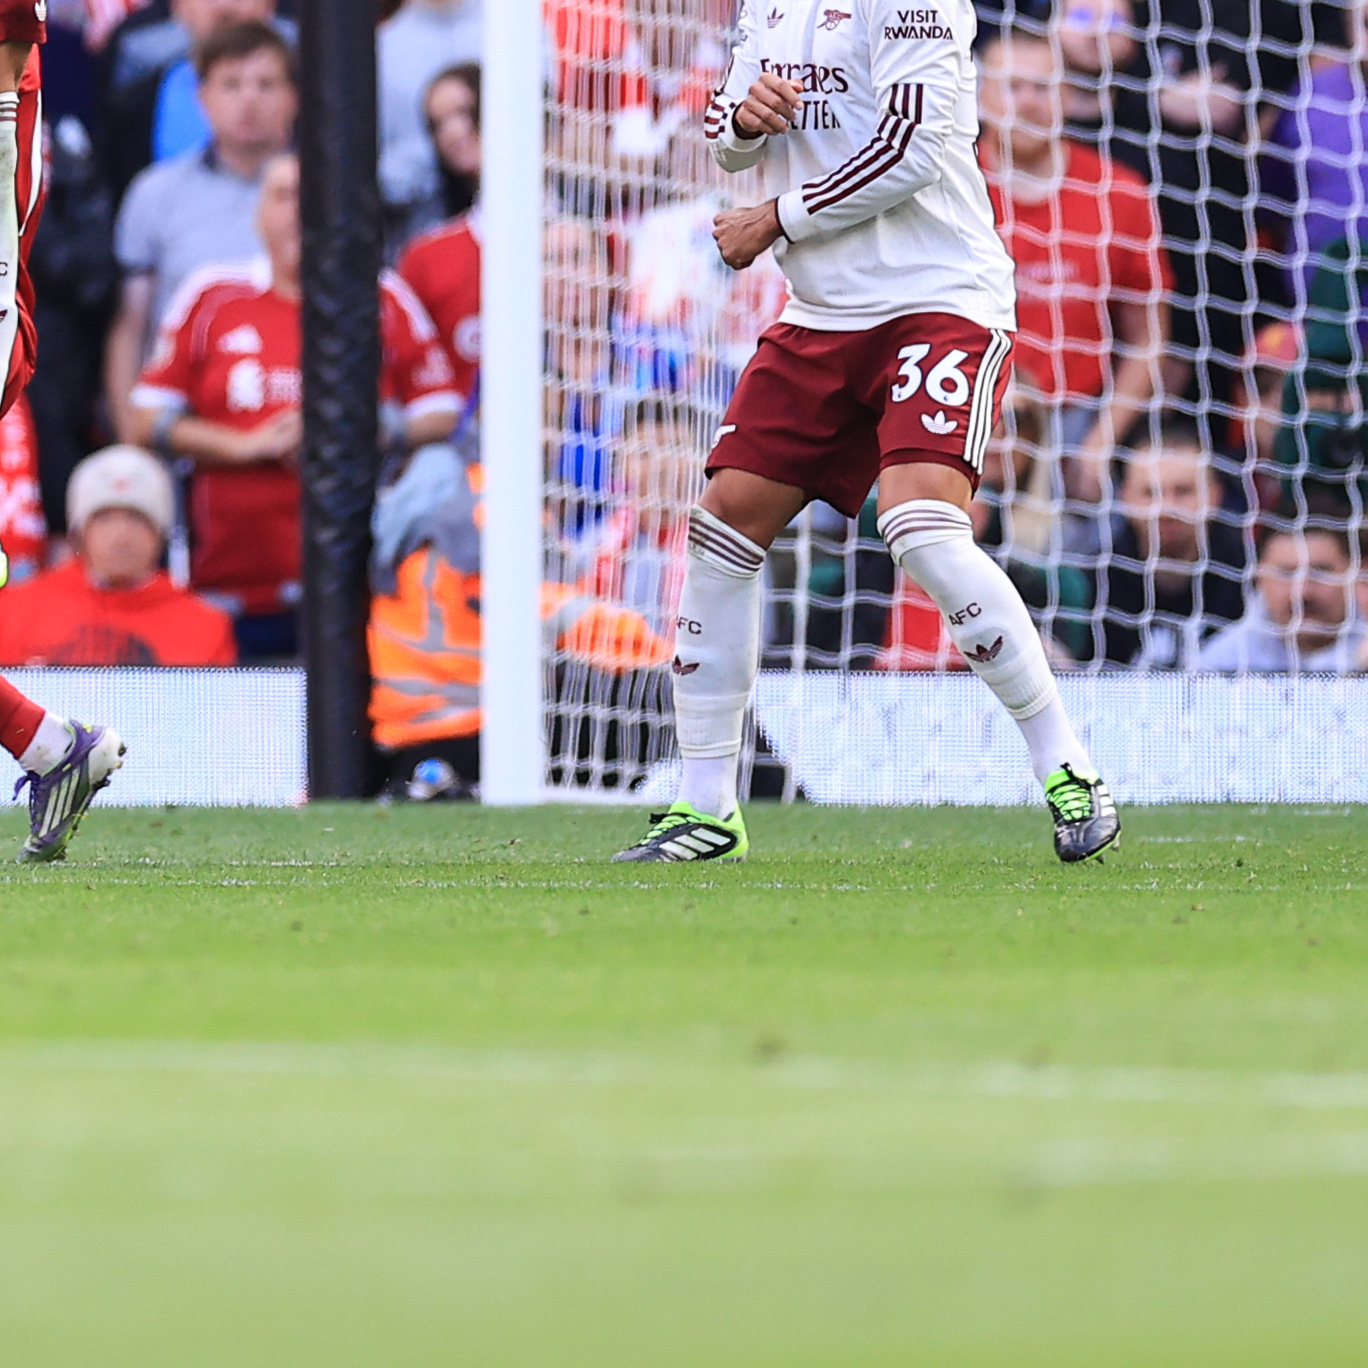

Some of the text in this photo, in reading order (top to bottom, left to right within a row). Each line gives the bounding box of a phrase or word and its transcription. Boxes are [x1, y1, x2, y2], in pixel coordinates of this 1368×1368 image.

[897, 10, 938, 23] VISIT
[884, 26, 953, 40] RWANDA
[891, 343, 970, 407] 36
[948, 602, 982, 626] AFC
[676, 615, 702, 635] FC
